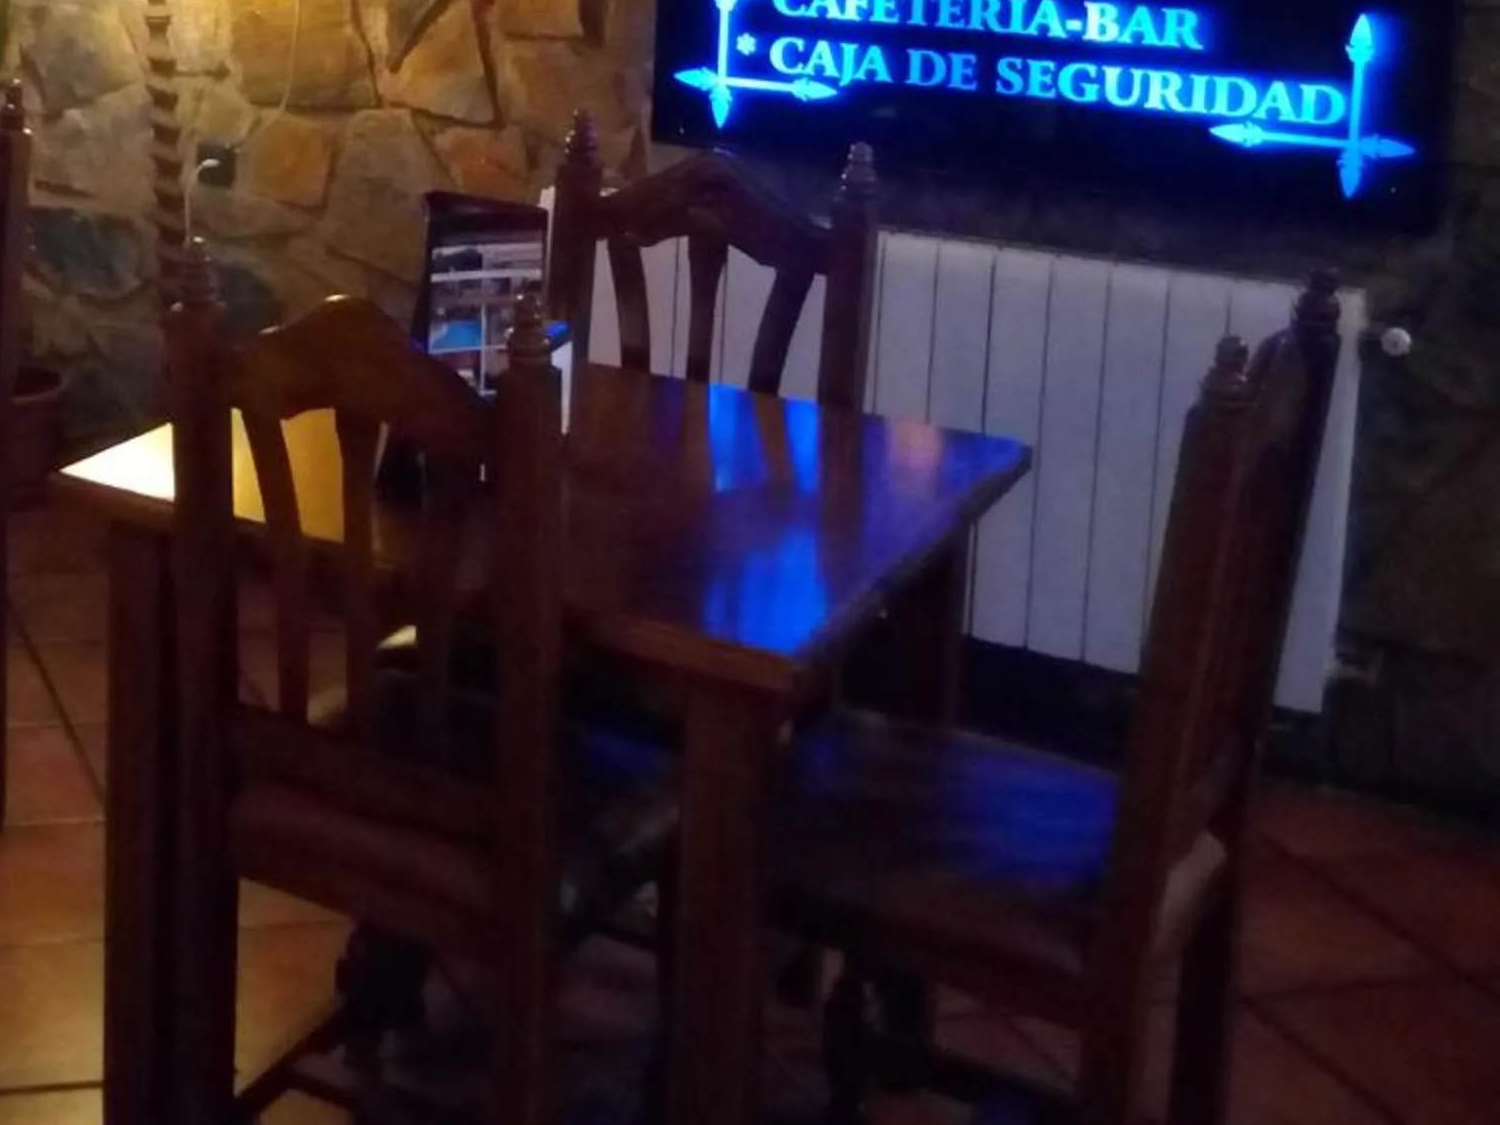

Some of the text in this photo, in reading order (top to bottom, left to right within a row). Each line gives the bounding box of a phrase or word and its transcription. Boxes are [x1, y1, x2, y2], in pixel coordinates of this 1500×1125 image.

[771, 36, 1345, 125] CAJA DE SEGURIDAD
